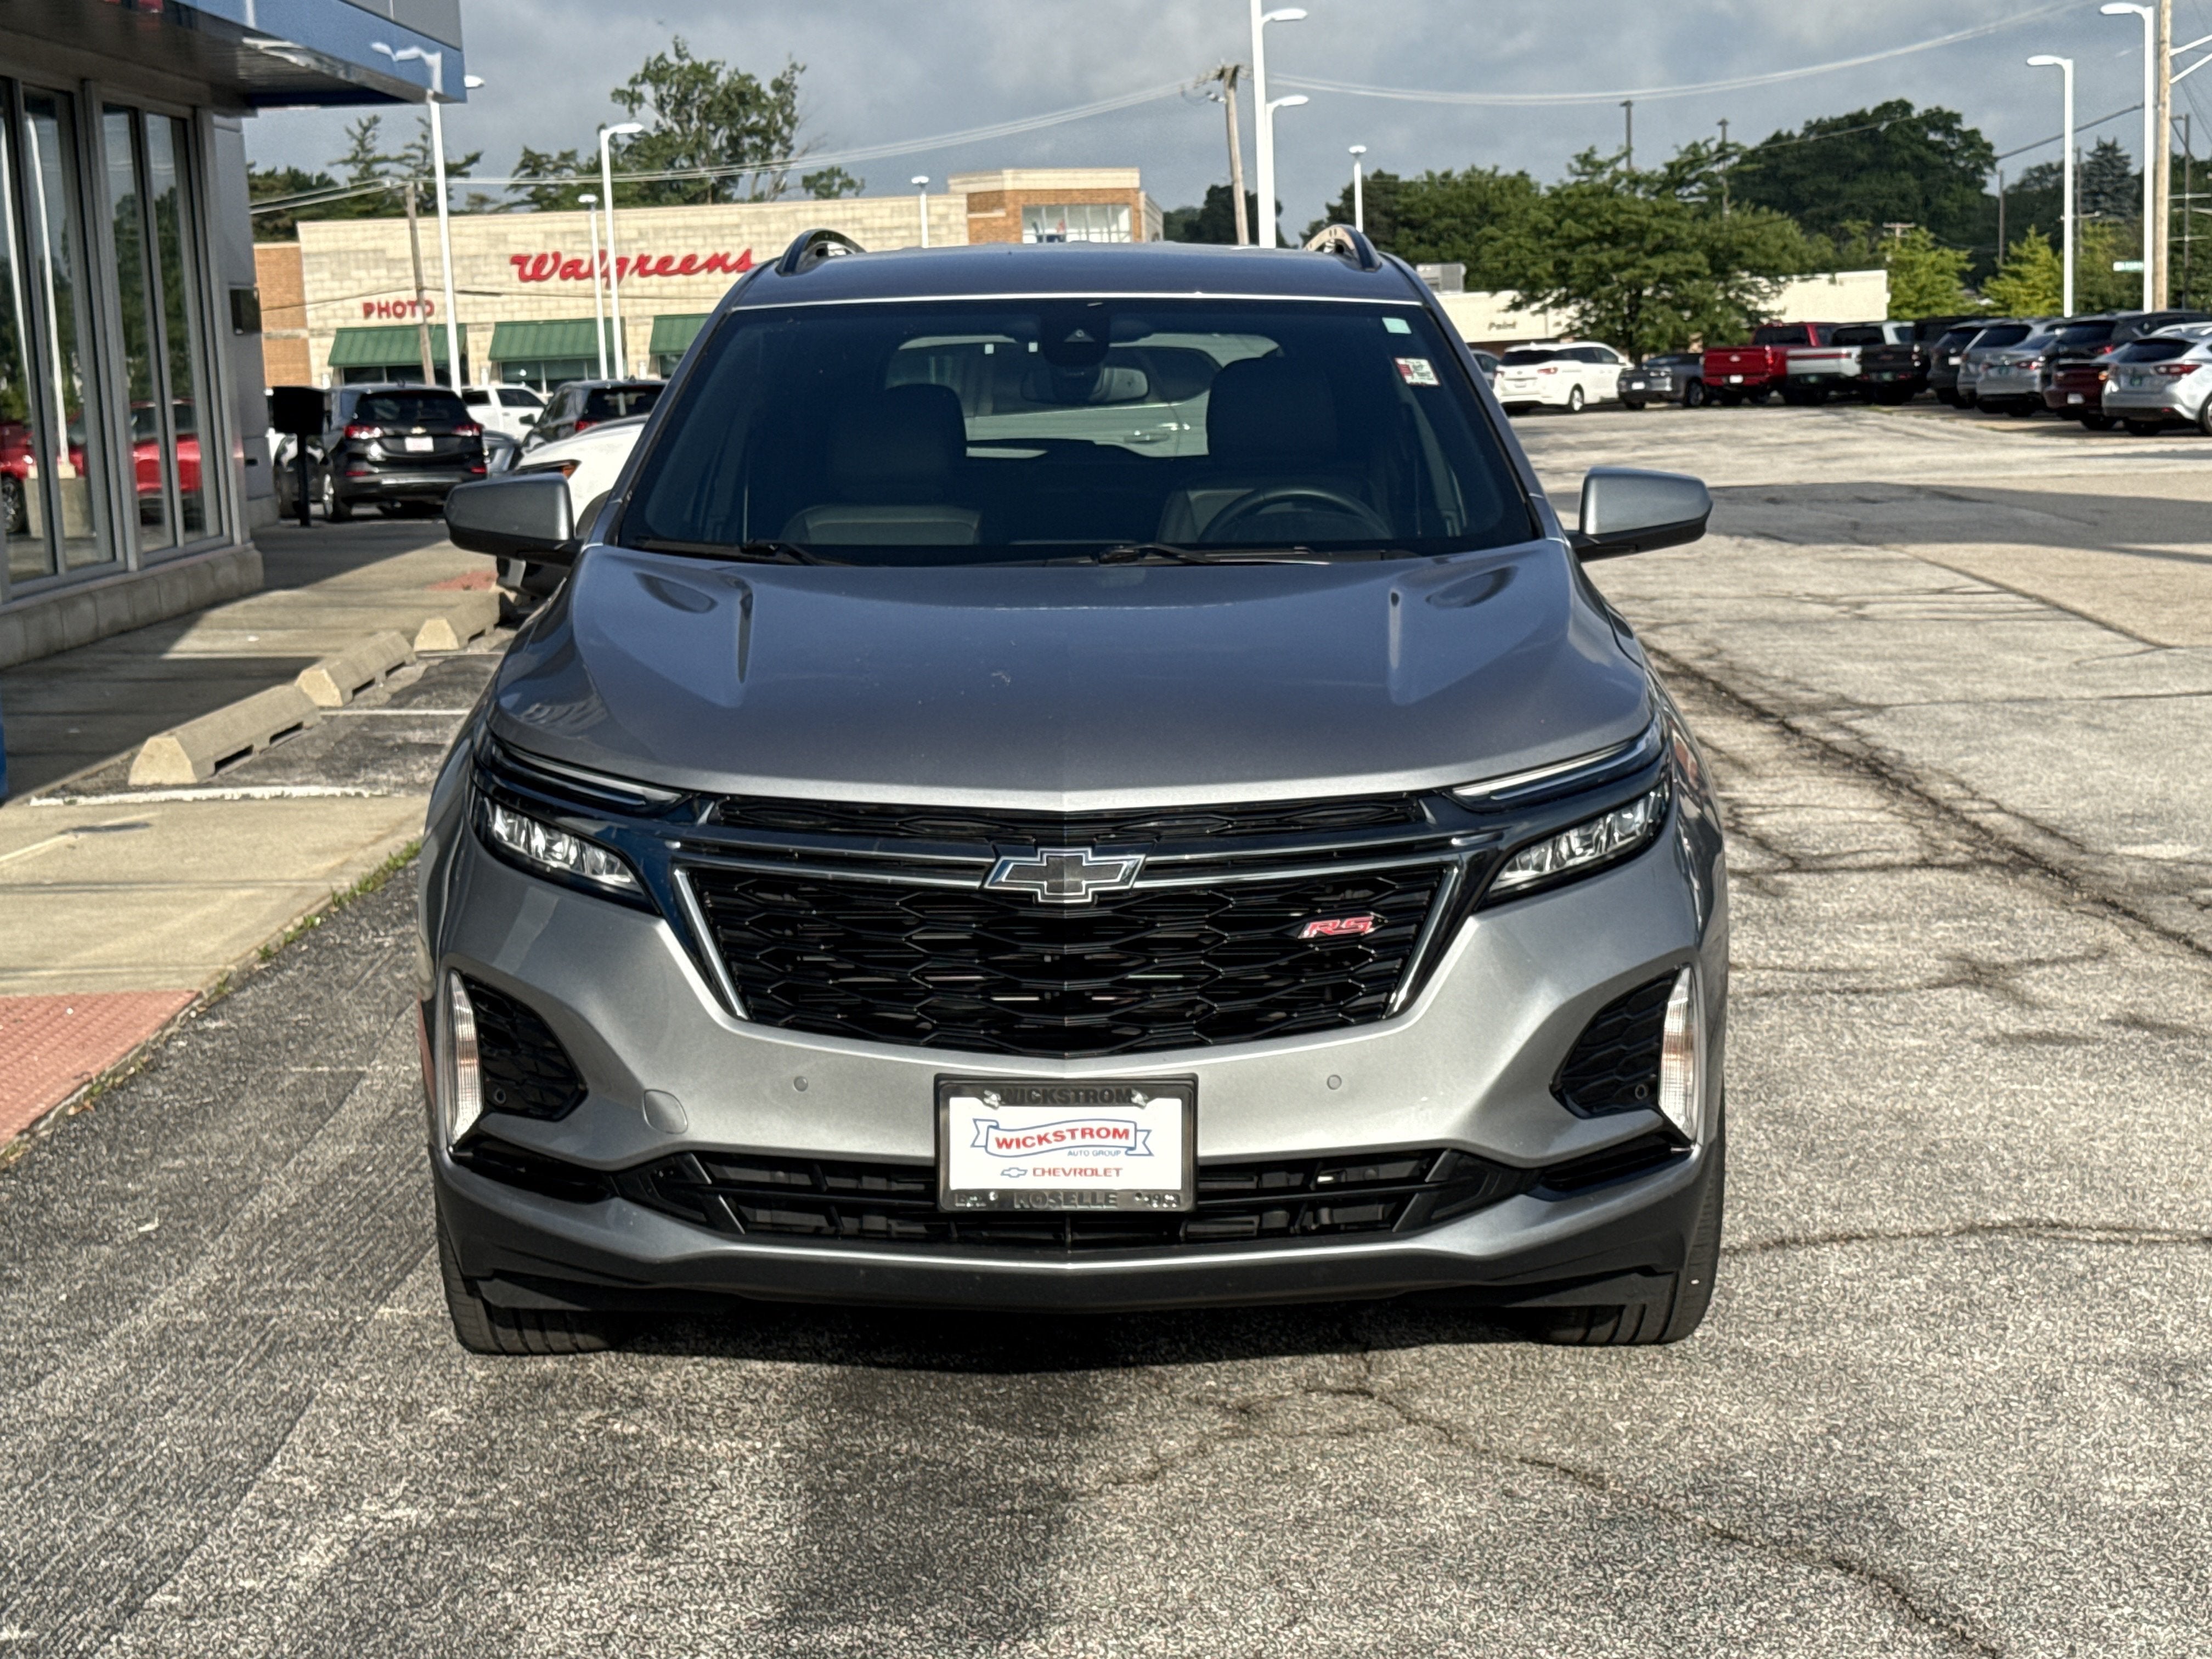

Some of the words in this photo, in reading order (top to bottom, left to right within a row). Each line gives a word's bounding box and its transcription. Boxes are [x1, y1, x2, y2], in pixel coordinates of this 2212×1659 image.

[510, 249, 755, 290] Walgreens
[363, 300, 435, 319] PHOTO
[1297, 916, 1374, 939] RS
[999, 1088, 1132, 1104] WICKSTROM
[995, 1127, 1130, 1149] WICKSTROM
[1032, 1167, 1124, 1177] CHEVROLET
[1014, 1191, 1118, 1209] ROSELLE
